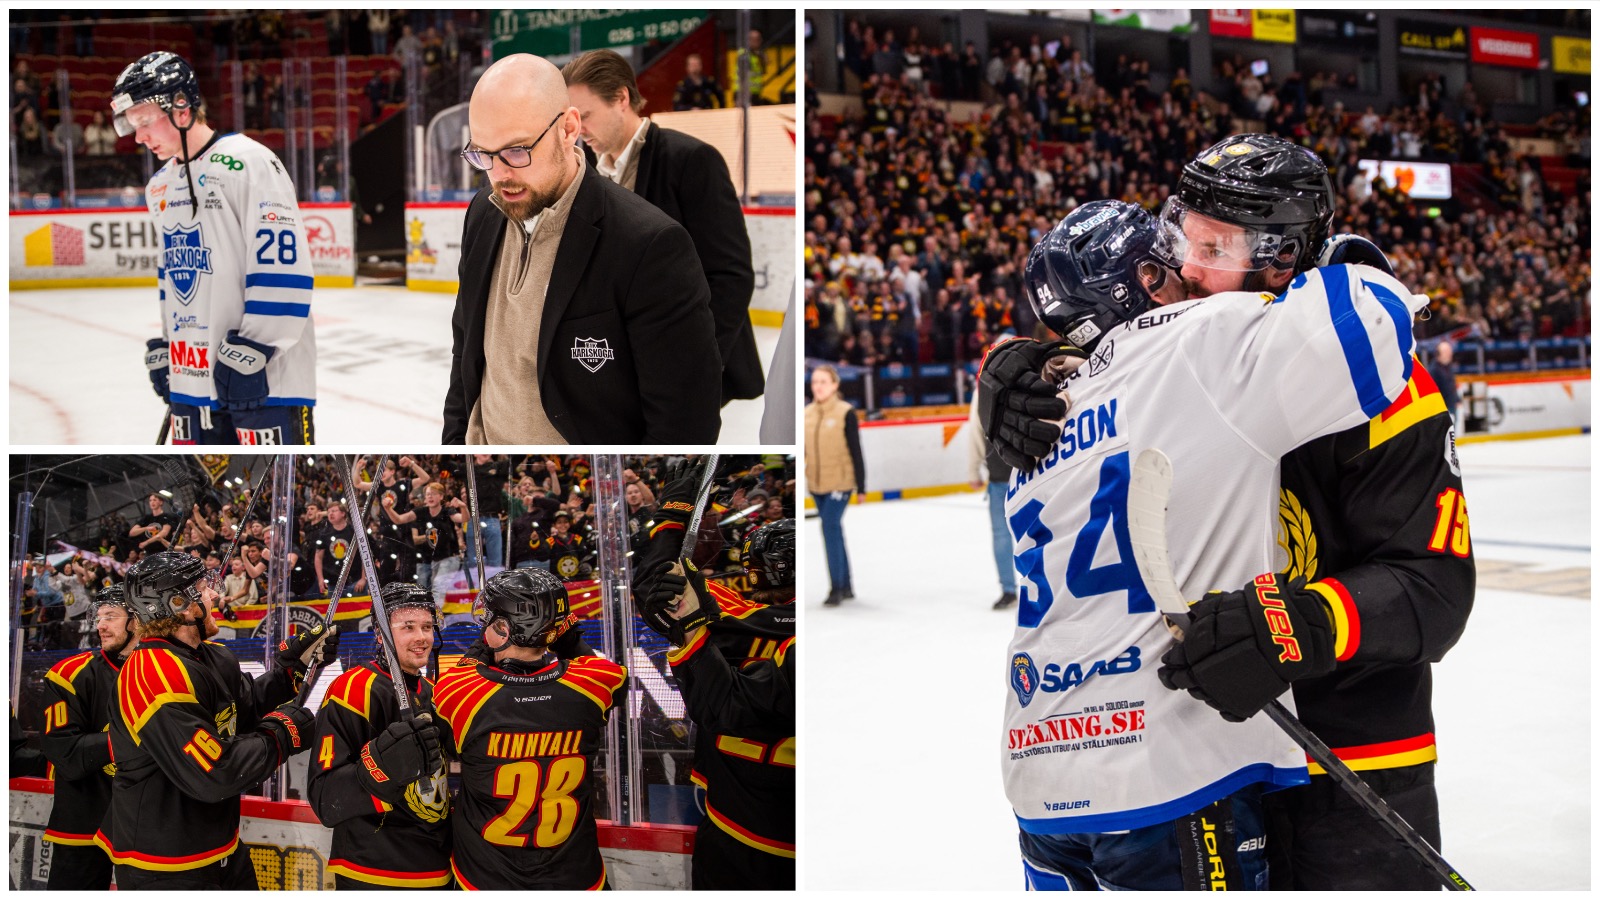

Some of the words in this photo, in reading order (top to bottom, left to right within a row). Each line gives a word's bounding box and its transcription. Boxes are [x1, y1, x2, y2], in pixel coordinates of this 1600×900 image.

[210, 153, 244, 171] coop
[256, 228, 297, 265] 28
[1037, 284, 1054, 305] 94
[1070, 324, 1094, 343] eyra
[170, 340, 209, 369] MAX
[218, 341, 257, 367] UER
[572, 347, 613, 359] KARLSKOGA
[1427, 487, 1471, 559] 15
[1040, 645, 1142, 693] SAAB
[521, 695, 552, 703] BAUER
[43, 700, 69, 735] 10
[182, 727, 223, 774] 16
[318, 734, 335, 770] 4
[486, 729, 583, 759] KINNVALL
[1024, 744, 1052, 758] STÖRSTA
[1082, 735, 1137, 750] STÄLLNINGAR
[481, 755, 586, 849] 28
[1051, 800, 1091, 811] BAUER
